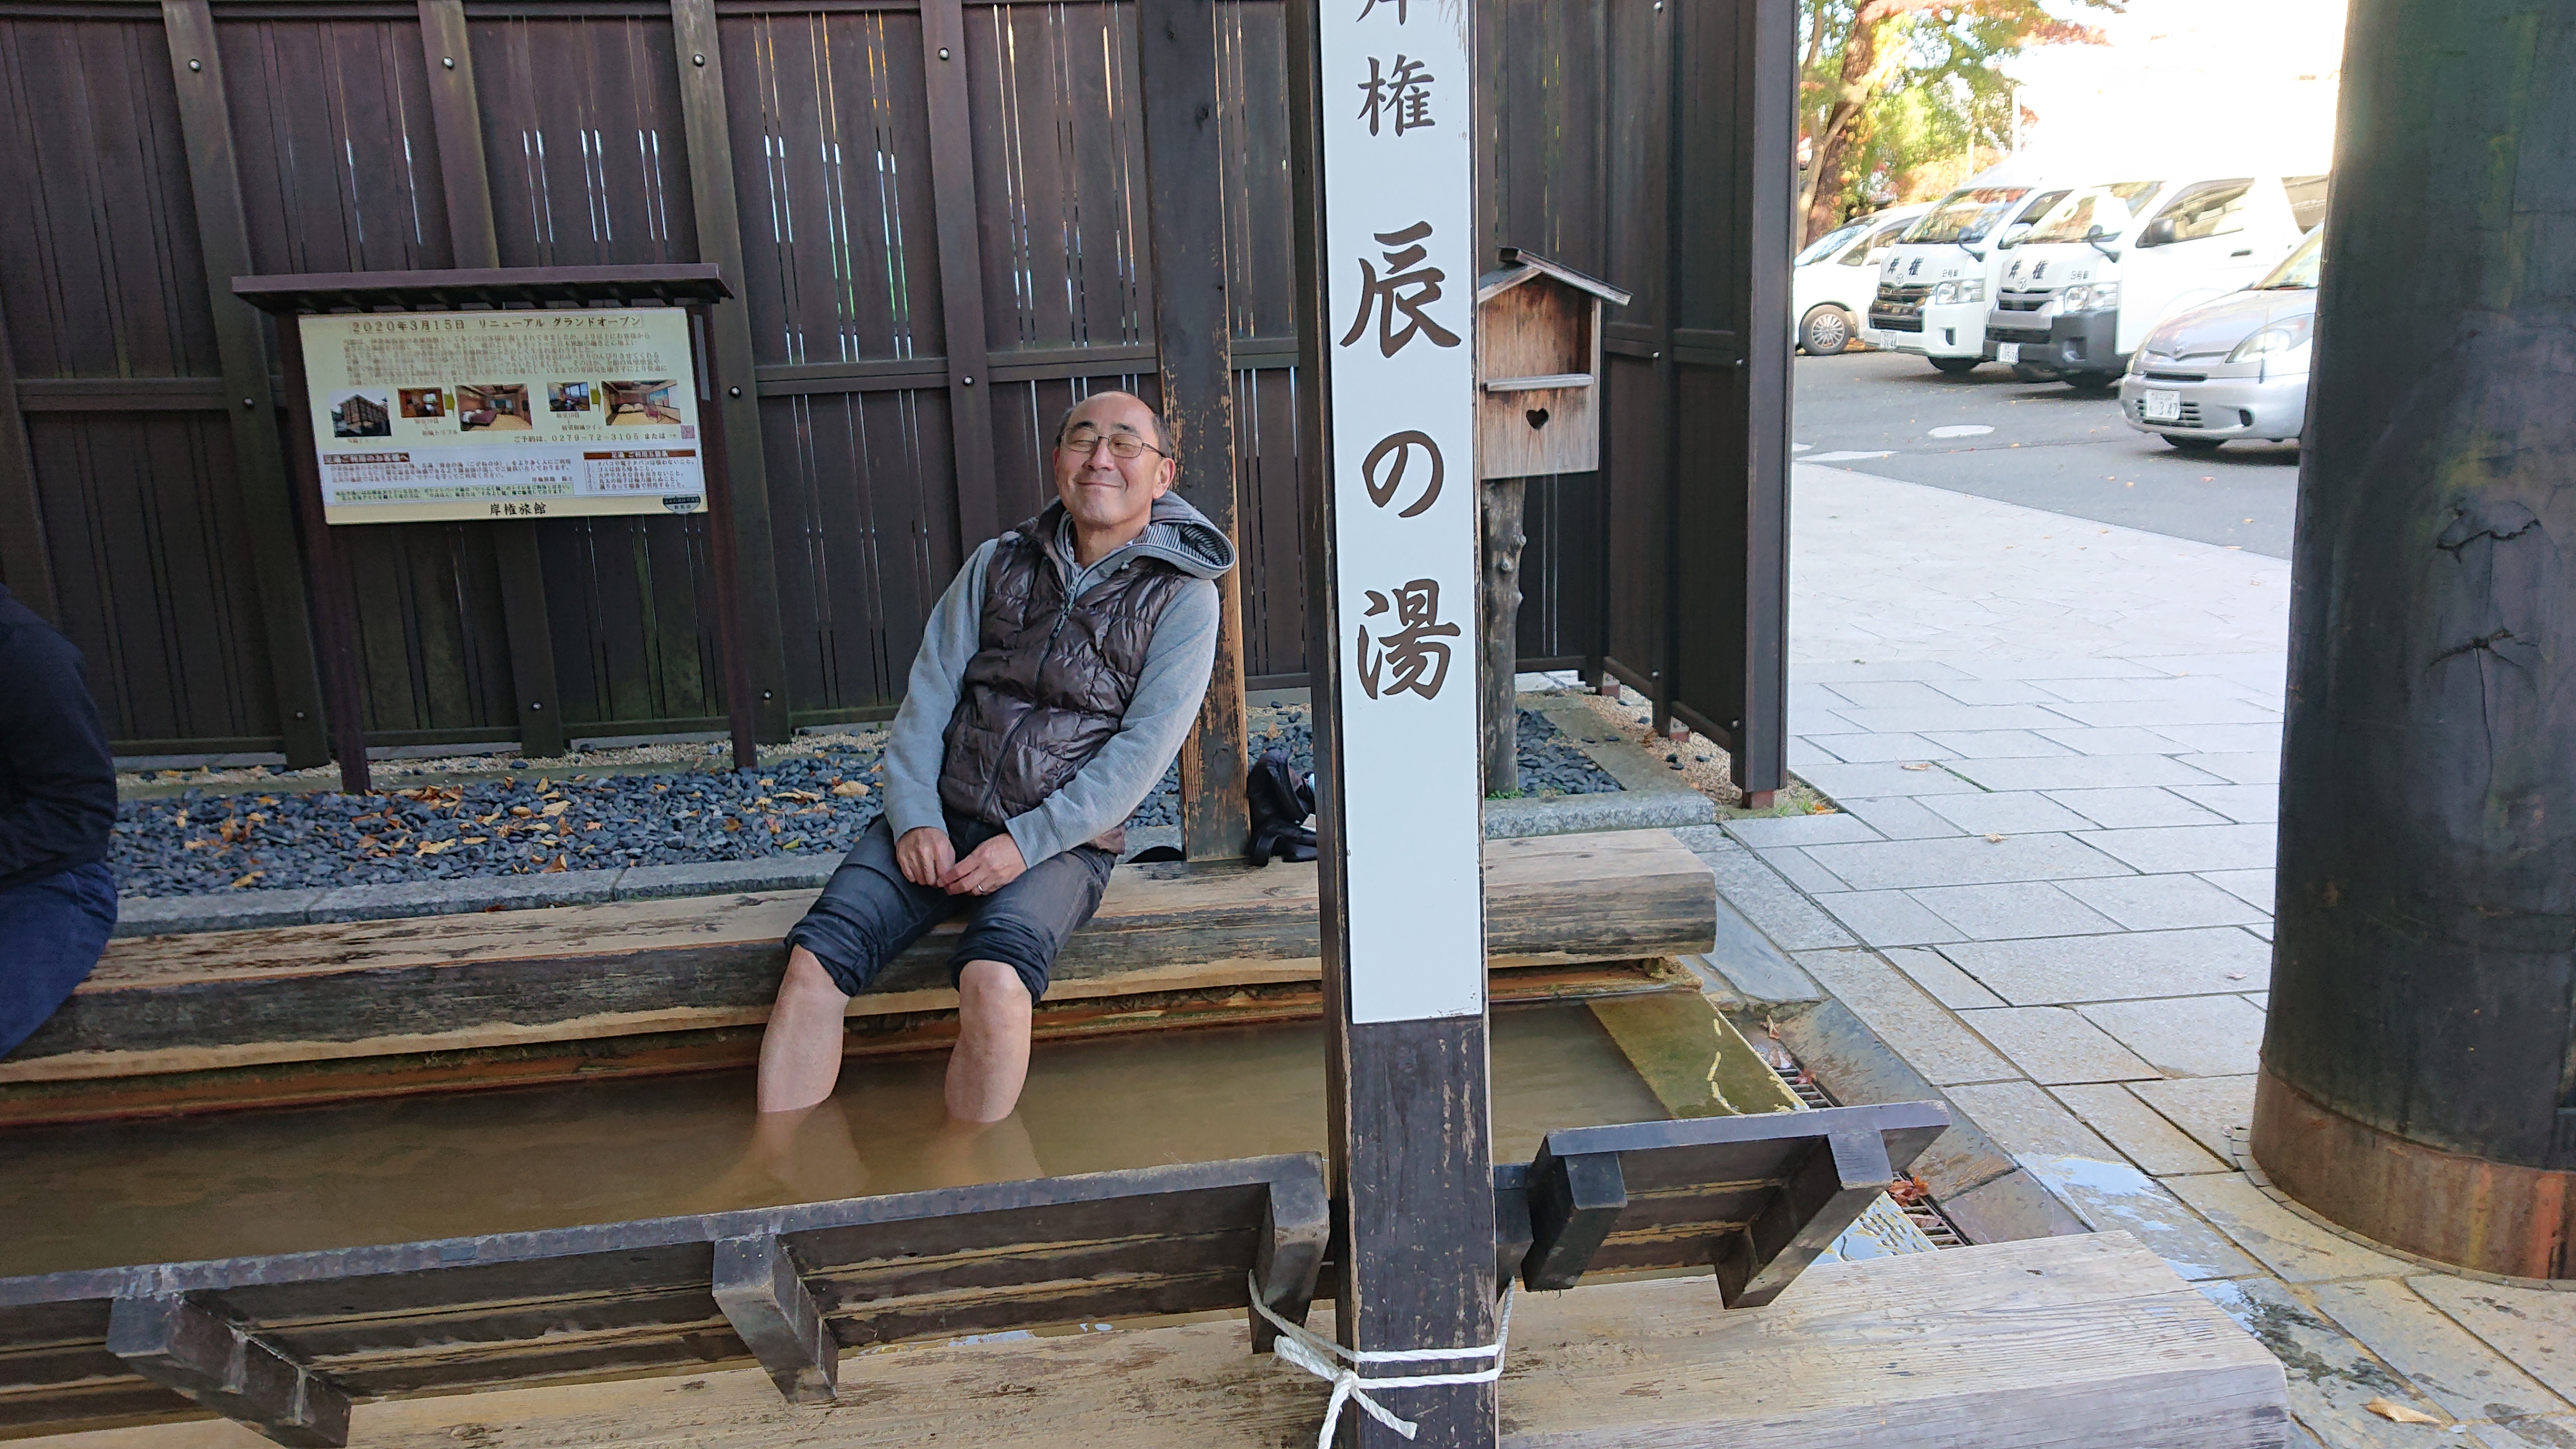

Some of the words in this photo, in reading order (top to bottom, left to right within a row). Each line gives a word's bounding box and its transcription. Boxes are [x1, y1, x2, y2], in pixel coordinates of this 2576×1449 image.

[352, 319, 465, 332] 2020年3月15日
[479, 318, 544, 329] リニューアル
[553, 316, 642, 328] グランドオープン
[643, 430, 666, 439] または
[1339, 220, 1462, 700] 辰の湯
[489, 501, 547, 516] 岸権旅館
